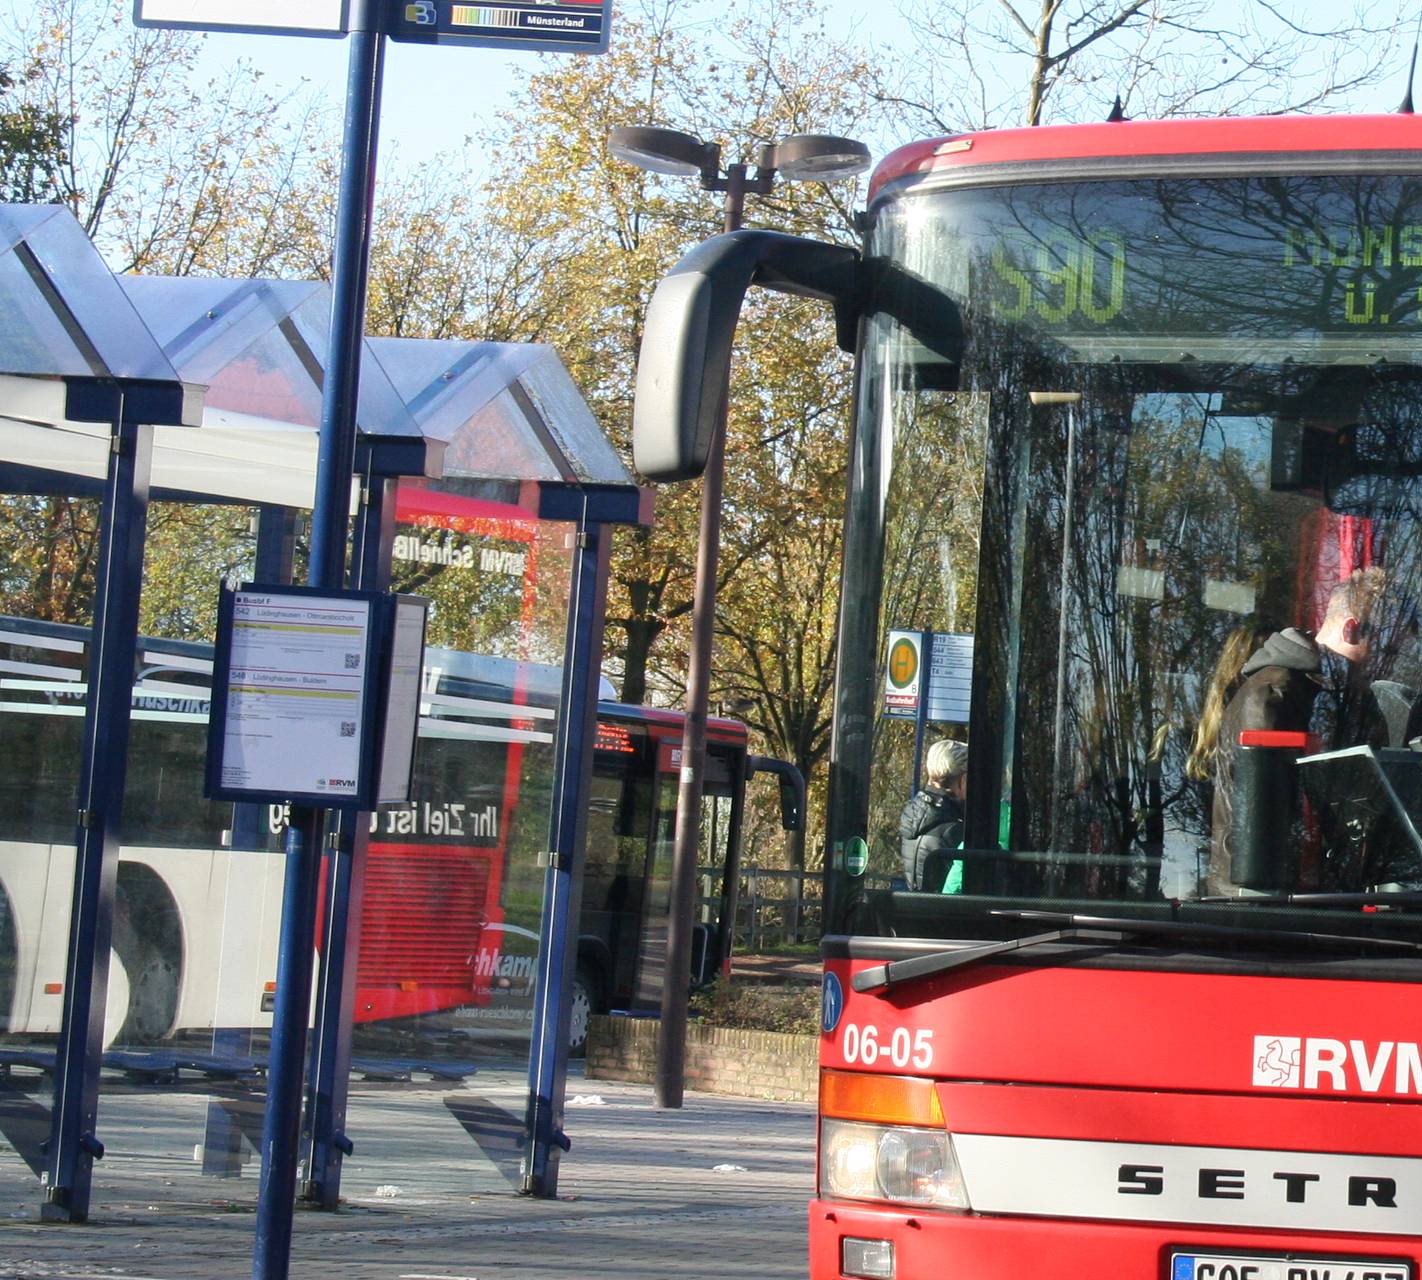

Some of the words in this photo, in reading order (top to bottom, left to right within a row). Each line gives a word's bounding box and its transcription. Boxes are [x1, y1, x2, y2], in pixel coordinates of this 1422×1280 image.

[526, 15, 585, 28] Münsterland
[992, 227, 1126, 325] S90
[1344, 282, 1390, 325] Ü.
[335, 778, 356, 787] RVM
[843, 1023, 934, 1069] 06-05
